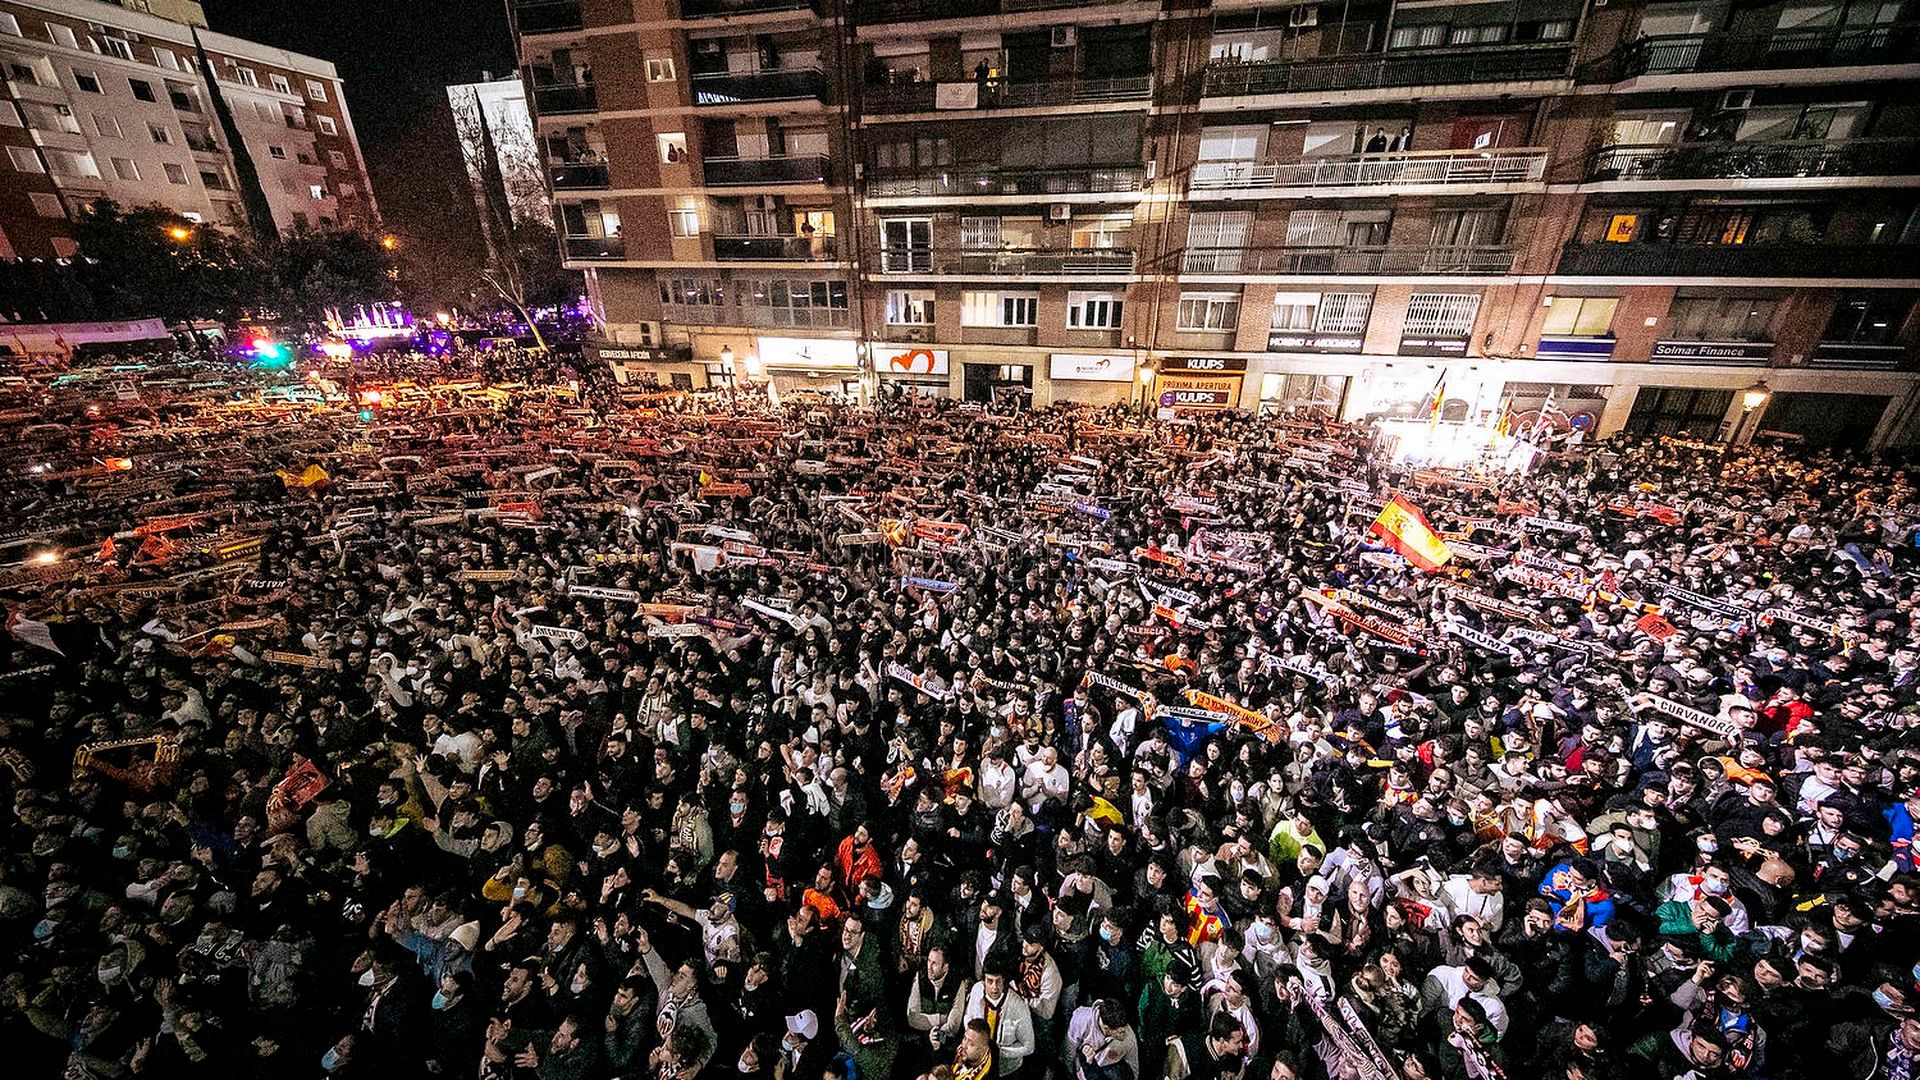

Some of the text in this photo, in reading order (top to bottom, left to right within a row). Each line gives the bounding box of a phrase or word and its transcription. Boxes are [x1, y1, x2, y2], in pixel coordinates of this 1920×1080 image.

[1656, 345, 1744, 356] Solmar Finance
[1187, 359, 1224, 369] KUUPS
[1195, 381, 1232, 390] APERTURA
[1175, 391, 1216, 403] KUUPS
